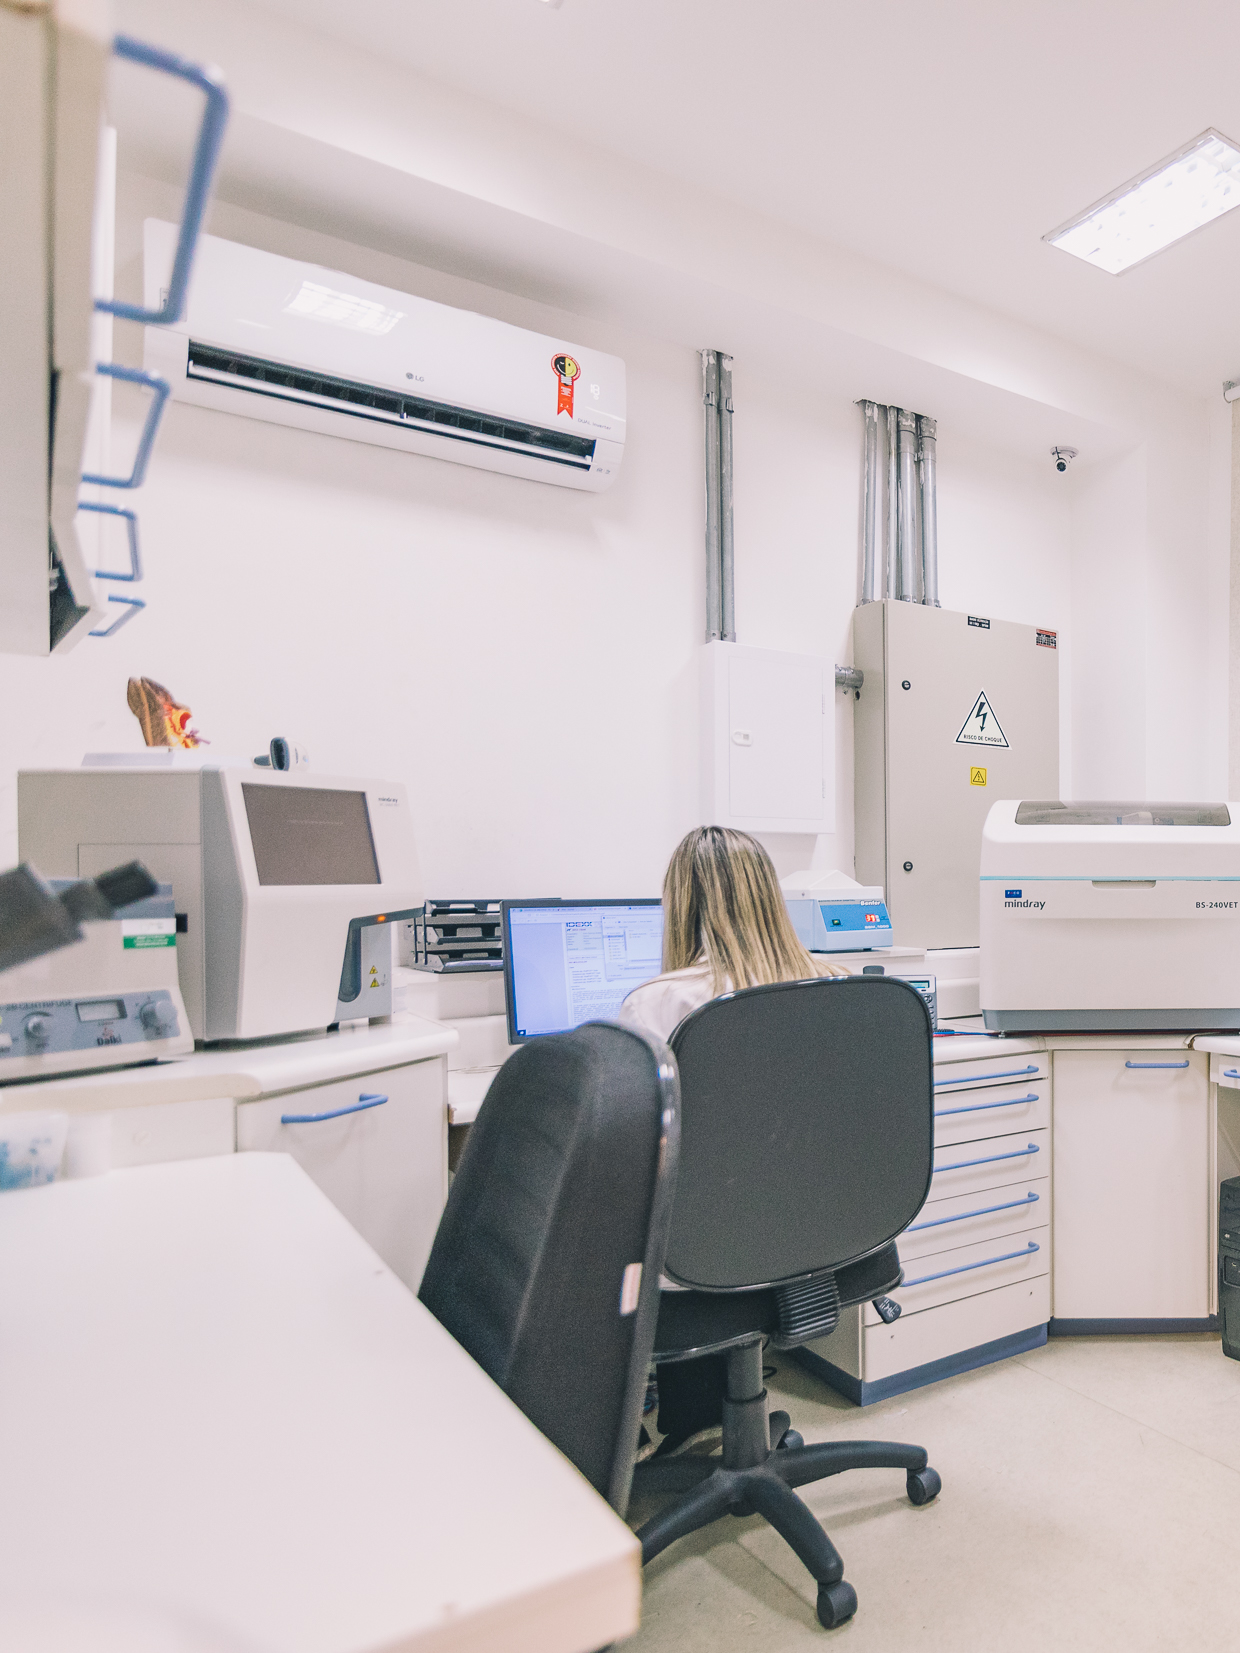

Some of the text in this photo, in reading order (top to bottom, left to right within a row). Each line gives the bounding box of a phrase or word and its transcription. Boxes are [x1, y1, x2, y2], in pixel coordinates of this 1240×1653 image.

[963, 733, 977, 741] RISCO
[1004, 899, 1046, 911] mindray
[1195, 901, 1239, 909] BS-240VET
